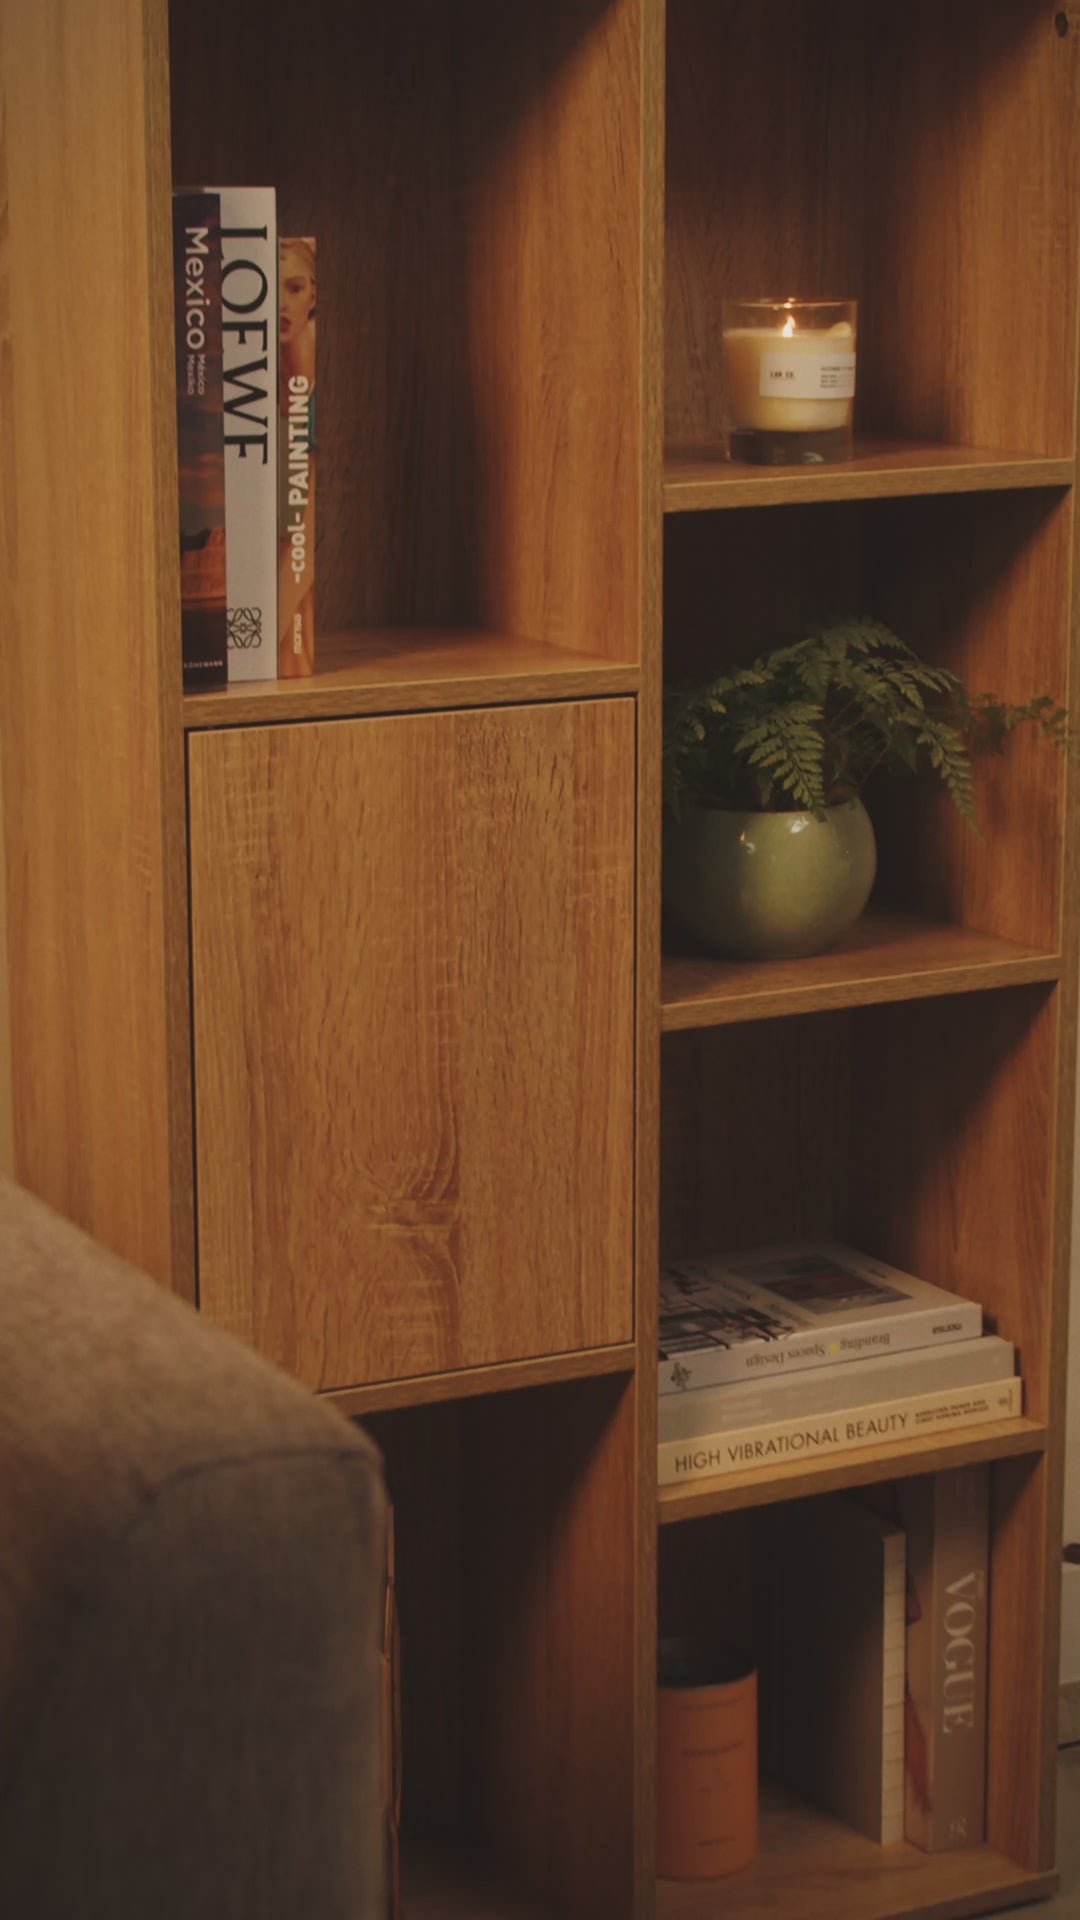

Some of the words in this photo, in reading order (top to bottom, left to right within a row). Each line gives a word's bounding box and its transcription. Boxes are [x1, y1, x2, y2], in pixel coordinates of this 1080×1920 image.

[185, 226, 211, 350] Mexico
[288, 375, 309, 505] PAINTING
[746, 1351, 785, 1368] Design
[787, 1344, 827, 1358] Spaces
[840, 1333, 891, 1351] Branding
[675, 1449, 721, 1474] HIGH
[728, 1426, 839, 1463] VIBRATIONAL
[846, 1413, 909, 1441] BEAUTY
[944, 1570, 977, 1735] VOGUE
